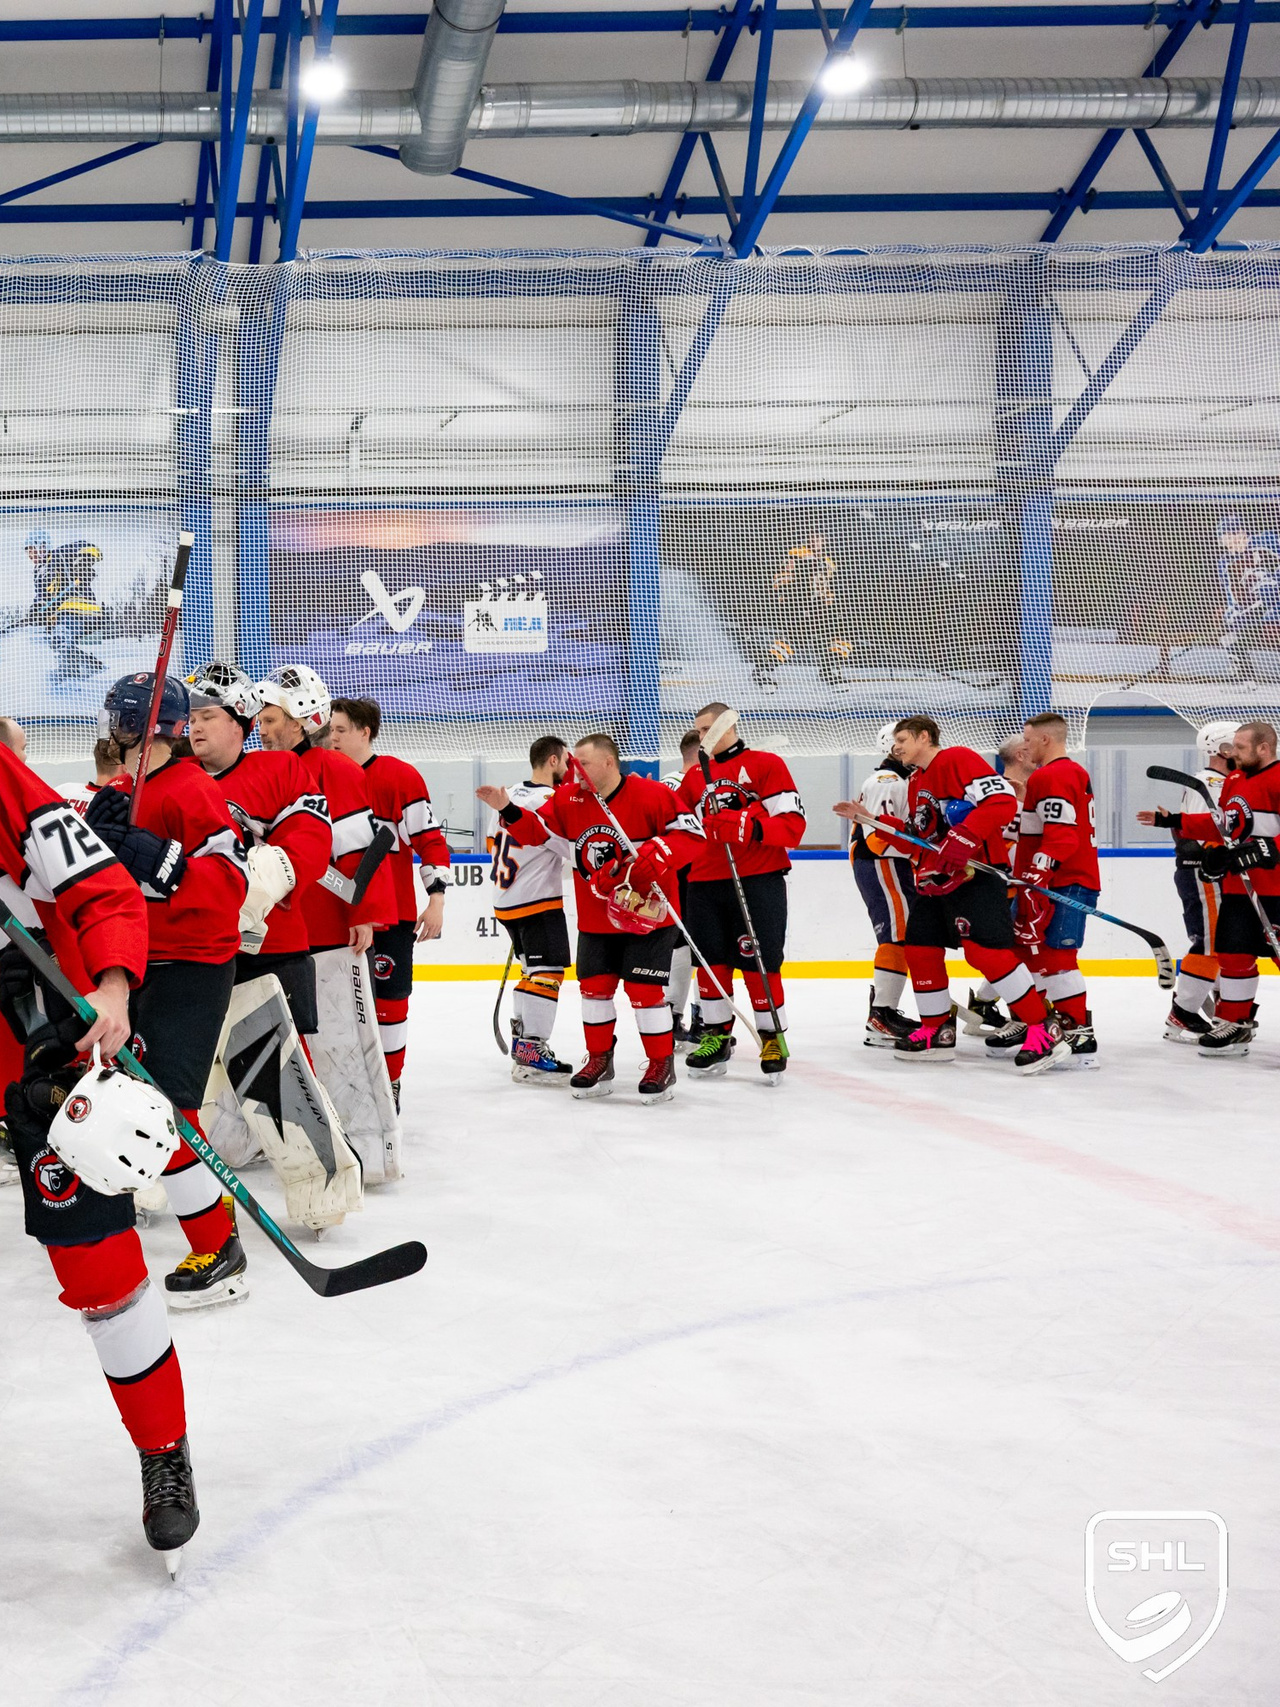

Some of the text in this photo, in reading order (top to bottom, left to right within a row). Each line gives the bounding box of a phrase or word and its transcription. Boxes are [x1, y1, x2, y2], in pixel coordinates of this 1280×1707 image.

[344, 641, 432, 655] BAUER
[979, 778, 1005, 795] 25
[38, 814, 103, 868] 72
[575, 826, 600, 851] HOCKEY
[631, 967, 670, 978] BAUER
[352, 964, 366, 1025] BAUER
[29, 1149, 51, 1173] HOCKEY
[191, 1134, 240, 1193] PRAGMA
[41, 1194, 78, 1209] MOSCOW
